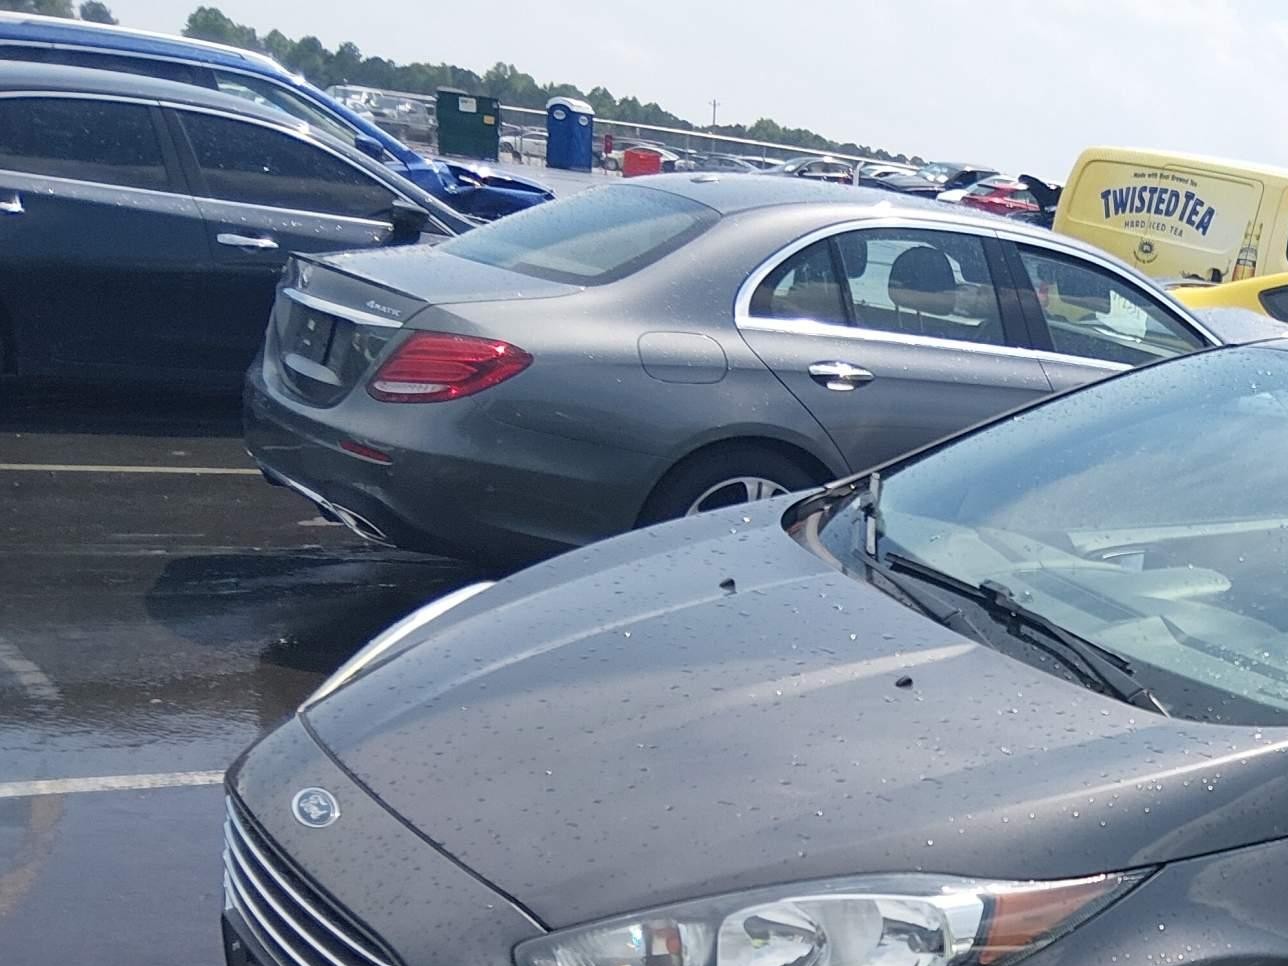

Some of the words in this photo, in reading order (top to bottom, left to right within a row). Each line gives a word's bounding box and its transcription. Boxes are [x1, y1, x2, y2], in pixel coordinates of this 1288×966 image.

[1100, 186, 1180, 219] TWISTED
[1178, 190, 1215, 236] TEA
[1124, 220, 1146, 229] HARD
[1149, 221, 1167, 232] ICED
[1170, 226, 1184, 237] TEA
